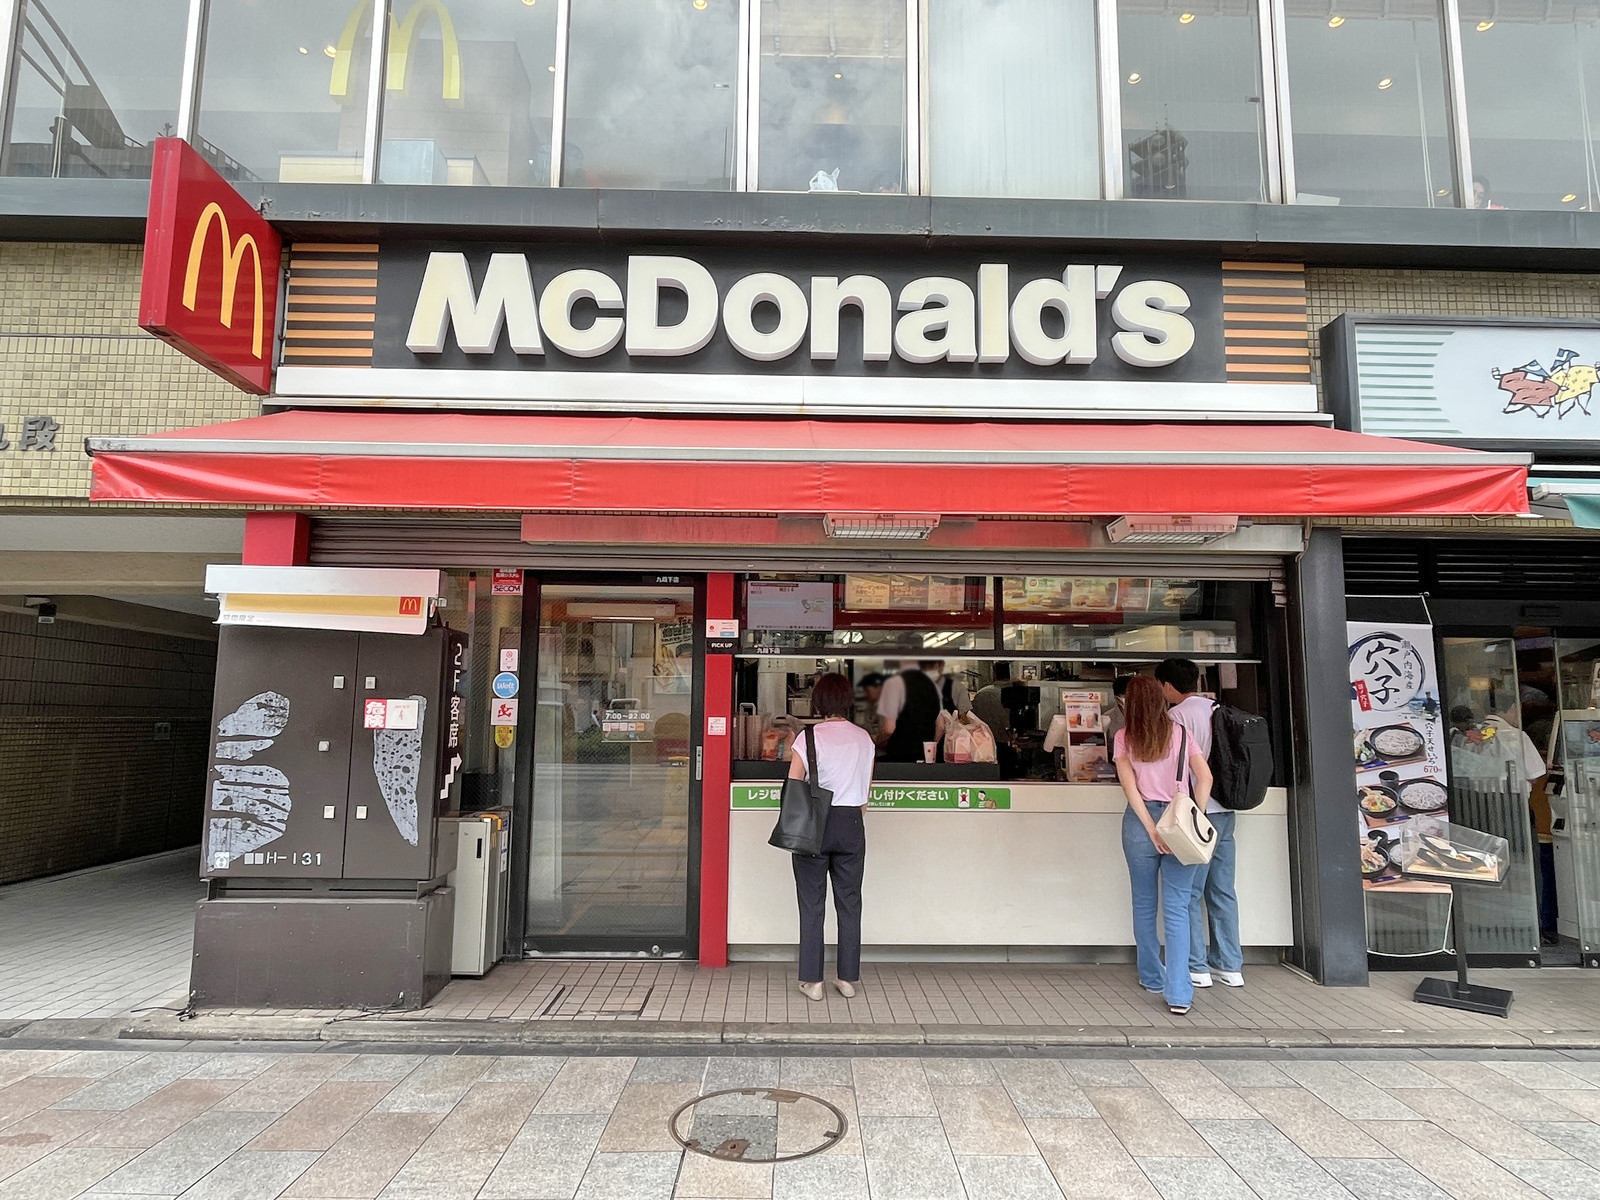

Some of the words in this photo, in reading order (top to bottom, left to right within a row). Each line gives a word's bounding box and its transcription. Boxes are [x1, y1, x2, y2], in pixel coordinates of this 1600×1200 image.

[404, 251, 1196, 368] McDonald's
[448, 642, 463, 749] 2F客席
[497, 682, 515, 690] Wolt
[1364, 640, 1402, 705] 穴子
